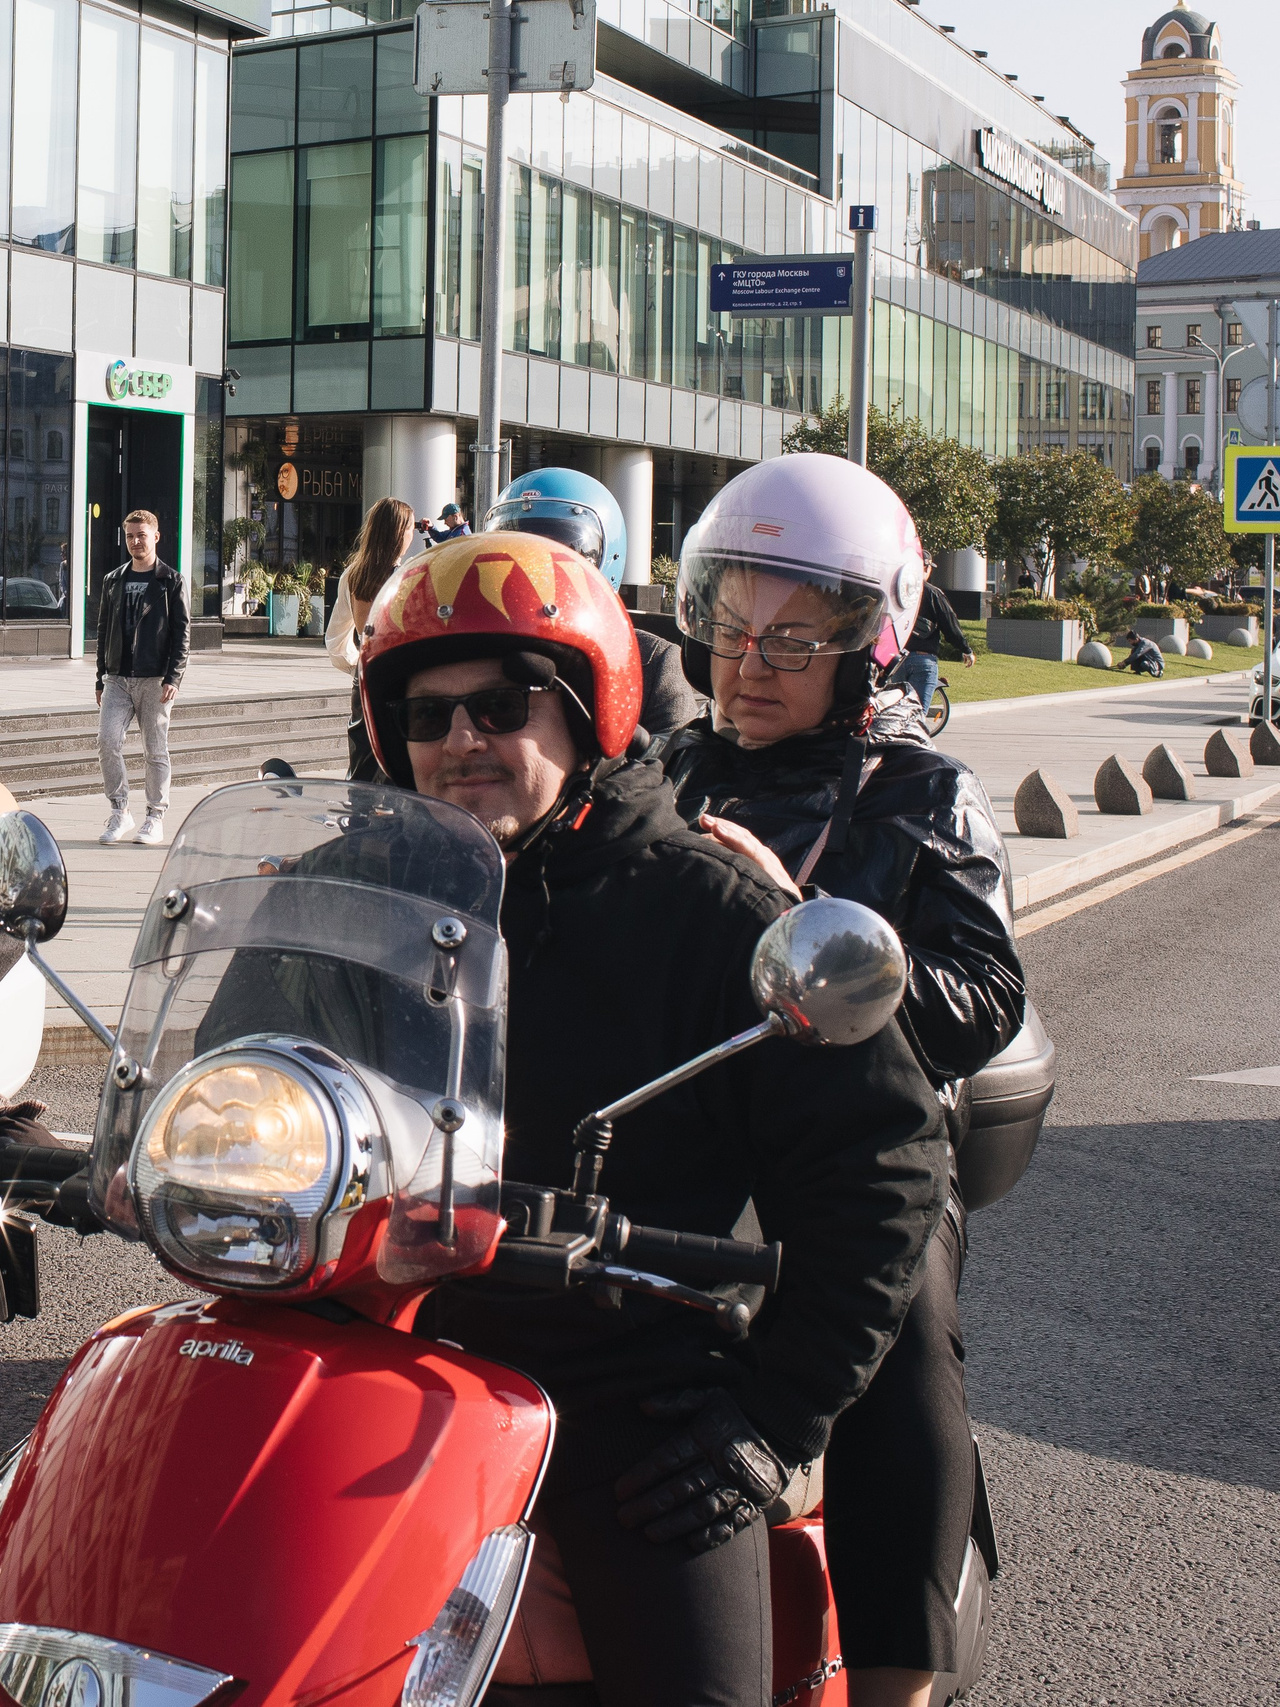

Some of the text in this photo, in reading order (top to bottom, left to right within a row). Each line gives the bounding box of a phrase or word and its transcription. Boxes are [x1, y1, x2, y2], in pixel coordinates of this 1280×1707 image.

[732, 269, 810, 279] ГКУ города Москвы
[732, 279, 766, 288] «МЦТО»
[131, 370, 173, 398] СБЕР
[303, 469, 343, 497] РЫБА
[179, 1339, 254, 1366] aprilia
